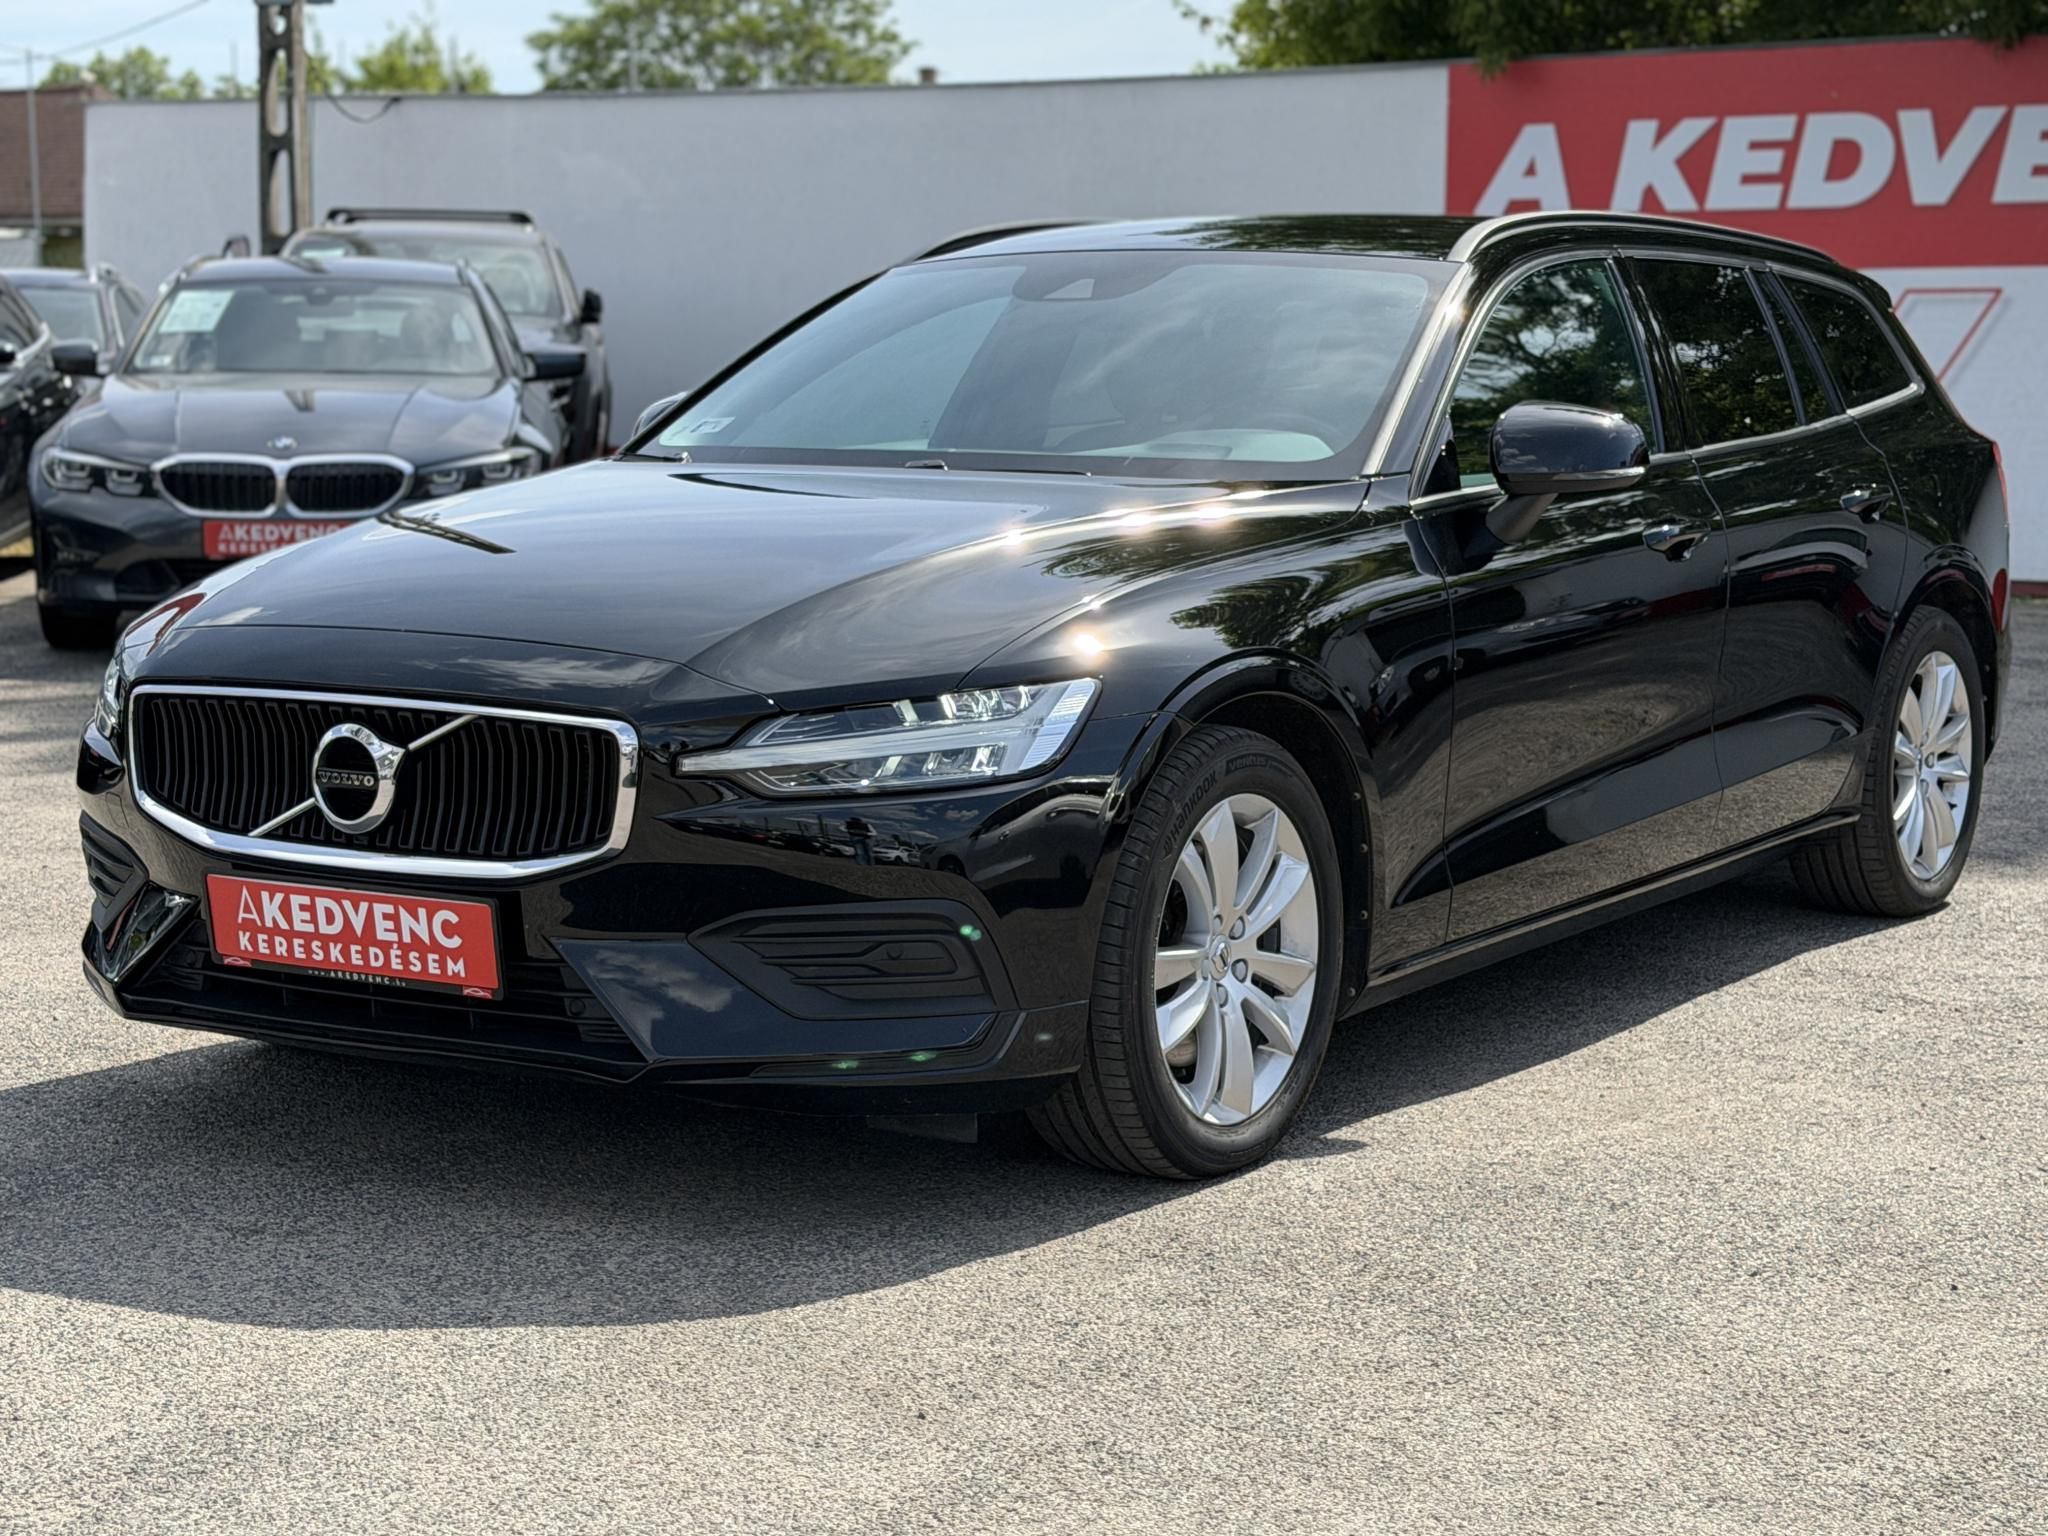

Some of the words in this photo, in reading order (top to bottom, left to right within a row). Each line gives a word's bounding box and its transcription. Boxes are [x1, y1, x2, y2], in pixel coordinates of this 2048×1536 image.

[1474, 123, 1571, 217] A
[318, 771, 375, 787] VOLVO
[237, 930, 467, 979] KERESKEDÉSEM
